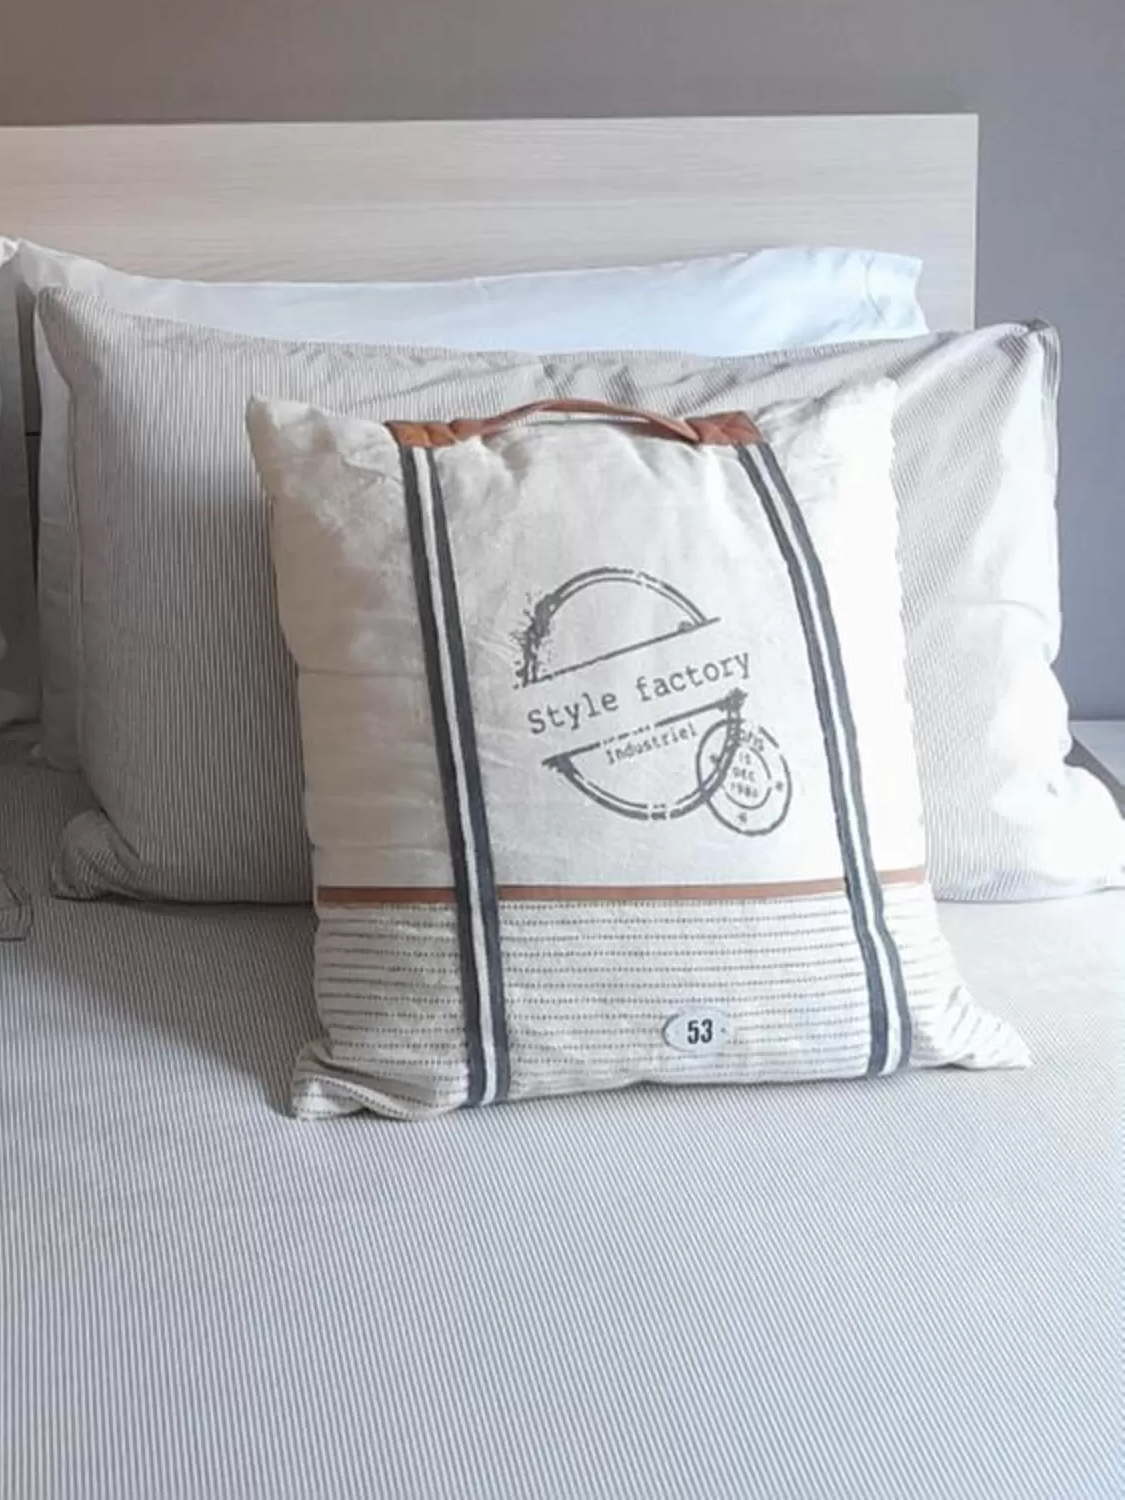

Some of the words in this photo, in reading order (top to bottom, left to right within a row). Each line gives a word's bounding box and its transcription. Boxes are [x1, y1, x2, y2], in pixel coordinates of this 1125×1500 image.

[527, 691, 619, 735] Style
[635, 652, 750, 702] factory
[606, 721, 697, 764] Industriel
[687, 1018, 713, 1045] 53
